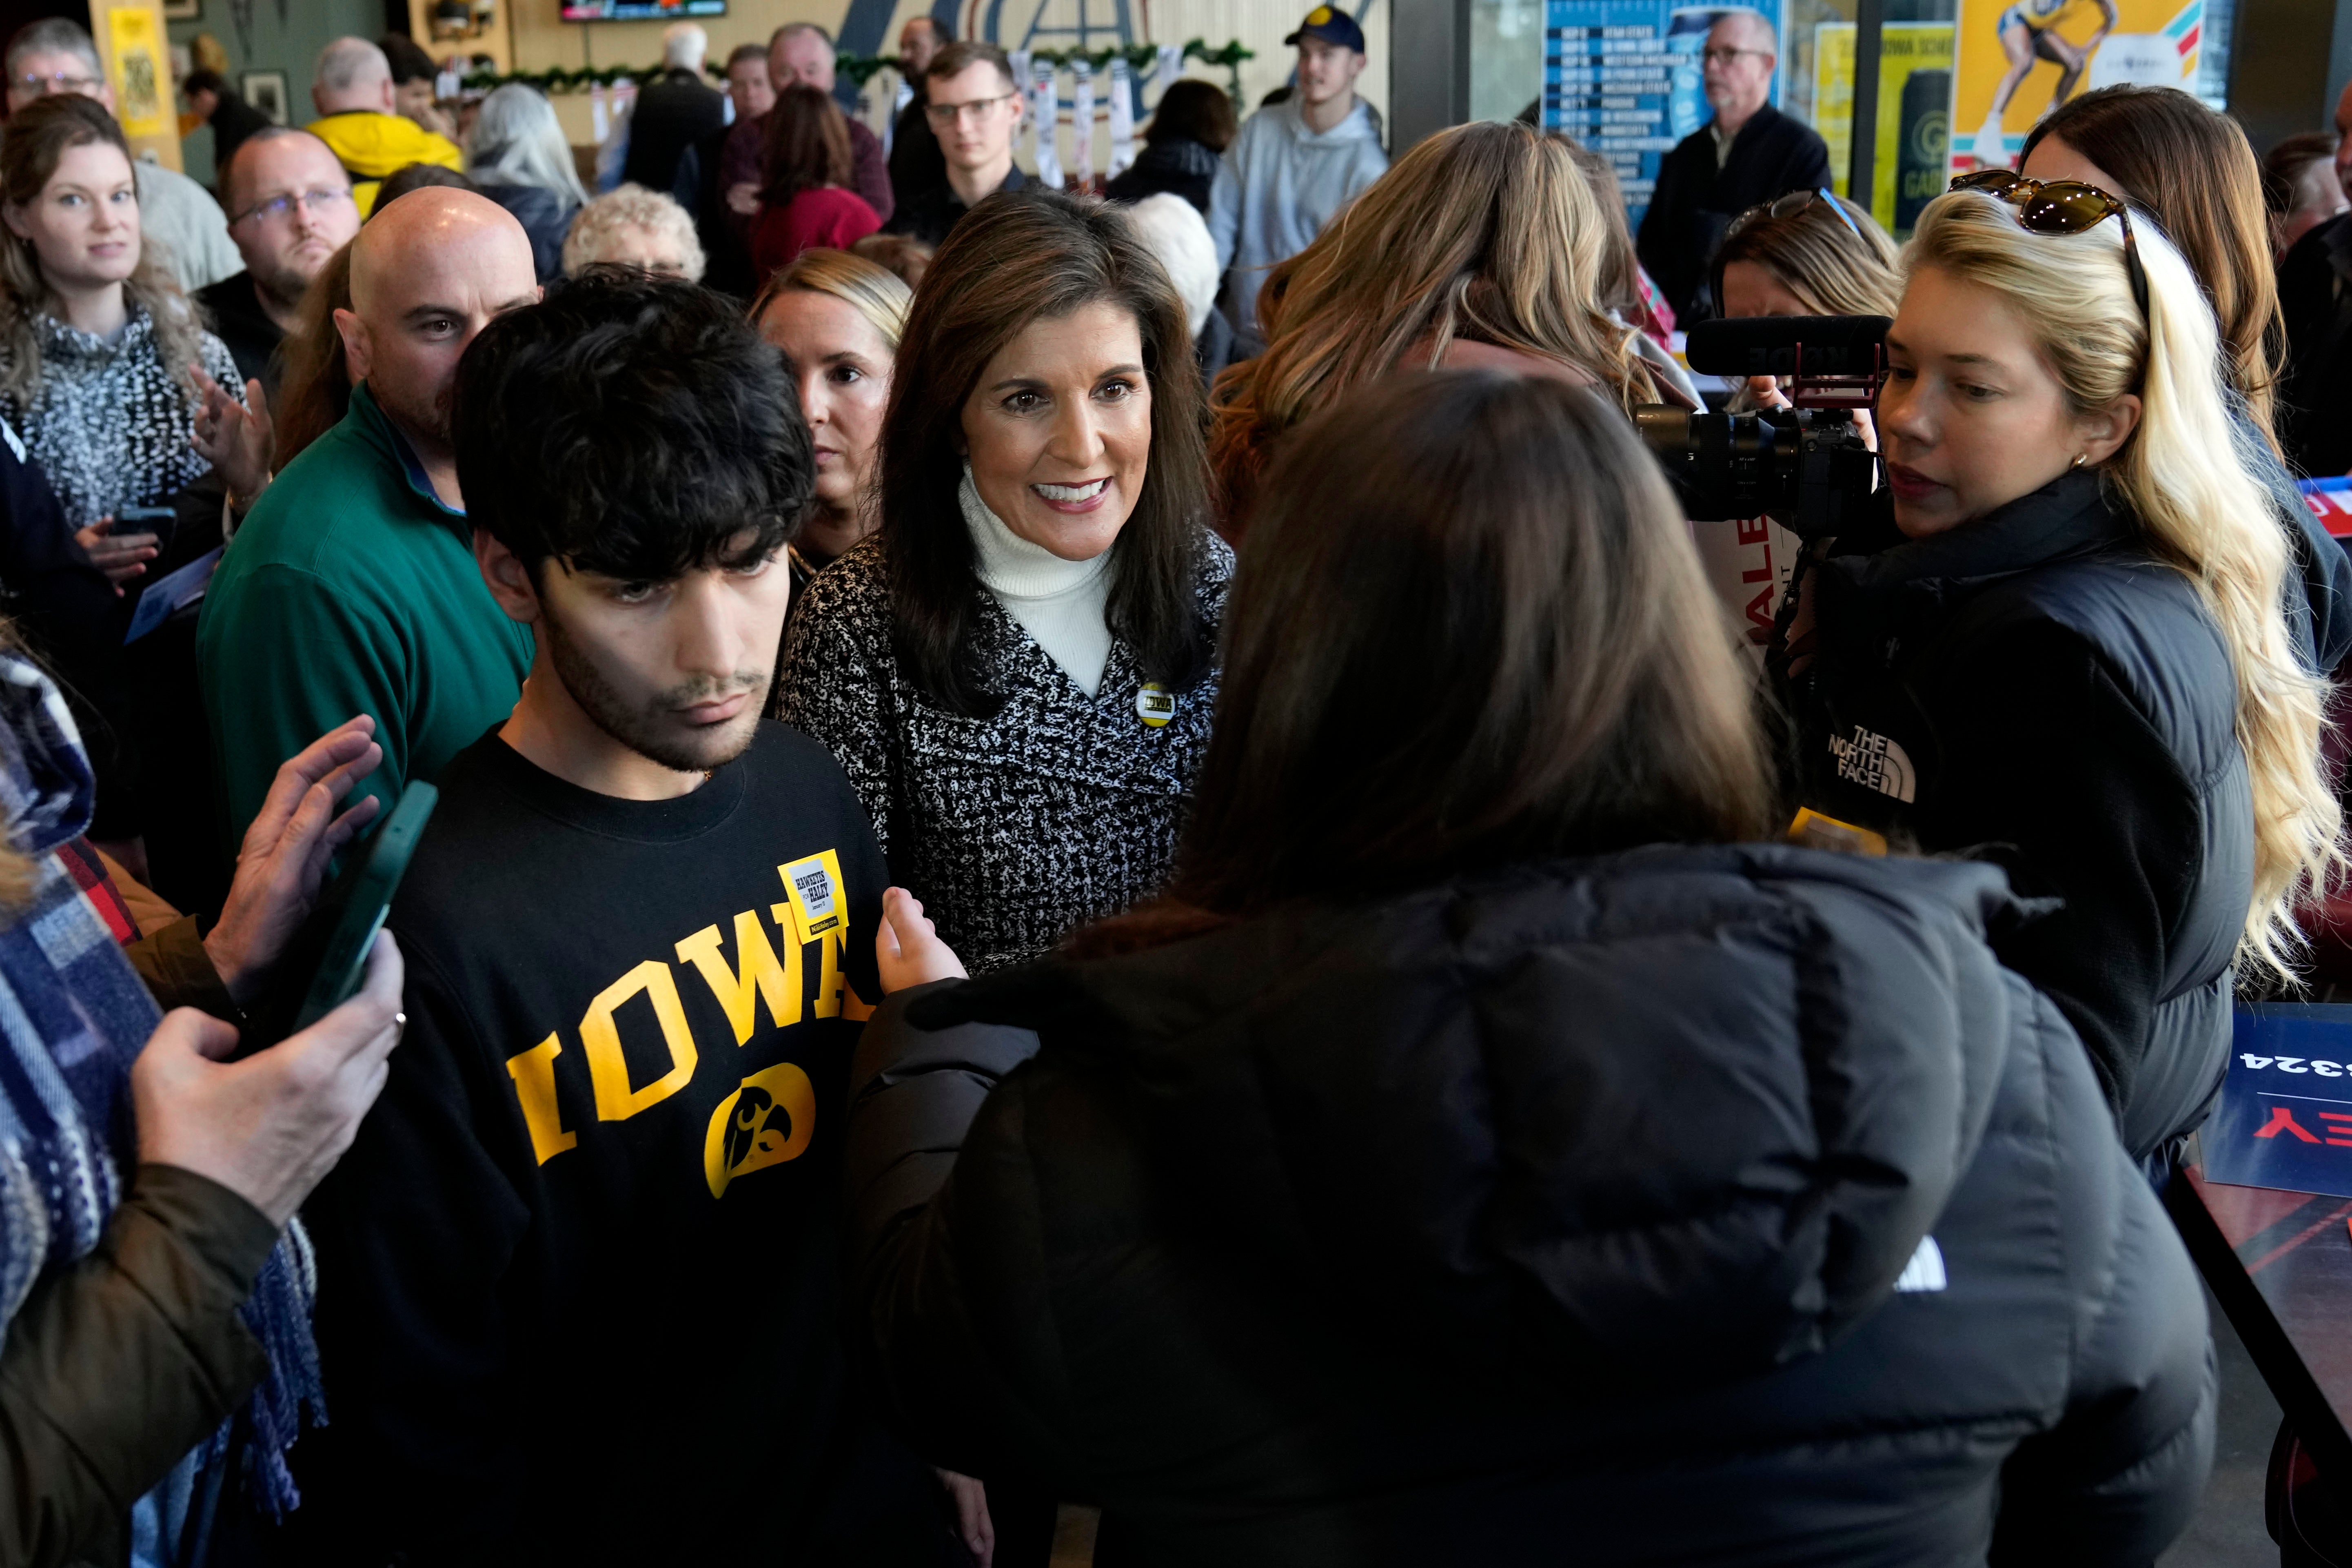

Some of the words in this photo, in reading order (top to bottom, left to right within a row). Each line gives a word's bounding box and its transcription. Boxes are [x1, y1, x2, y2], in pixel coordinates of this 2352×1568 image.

[1736, 514, 1775, 646] ALE
[1828, 734, 1884, 774] NORTH
[1854, 725, 1888, 755] THE
[1838, 757, 1881, 790] FACE
[796, 870, 825, 890] HAWKEYES
[808, 883, 829, 903] HALEY
[811, 918, 837, 933] NikkiHaley.com
[505, 902, 876, 1167] IOWA
[2239, 1053, 2352, 1078] 324
